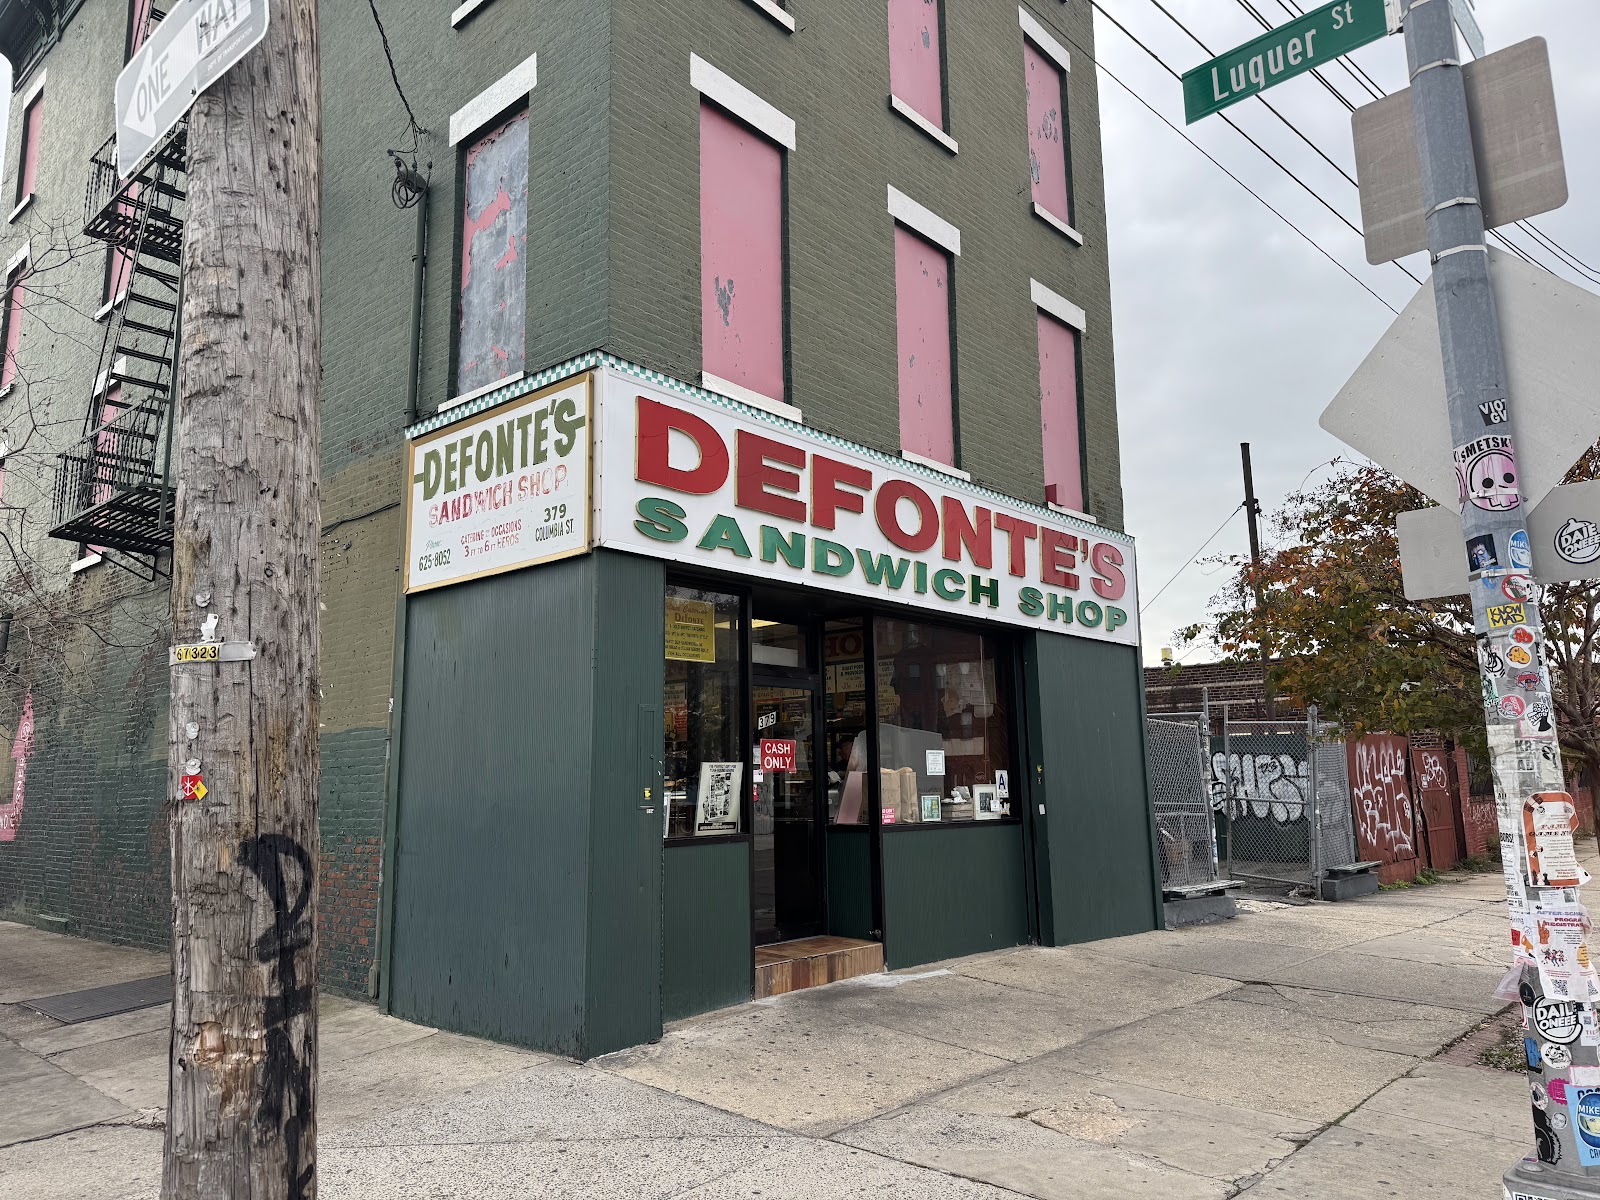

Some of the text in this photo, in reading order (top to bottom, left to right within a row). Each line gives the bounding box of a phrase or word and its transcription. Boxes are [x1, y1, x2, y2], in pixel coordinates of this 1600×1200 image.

[1211, 1, 1354, 102] Luquer St
[137, 52, 171, 122] ONE
[423, 398, 577, 501] DEFONTE'S
[428, 464, 568, 528] SANDWICH SHOP
[634, 395, 1126, 600] DEFONTE'S
[544, 503, 567, 523] 379
[460, 530, 485, 546] CATERING
[490, 519, 522, 538] OCCASIONS
[535, 521, 564, 542] COLUMBIA
[464, 545, 470, 558] 3
[484, 540, 490, 552] 6
[497, 532, 520, 549] HEROS
[418, 548, 451, 572] 625-8052
[633, 497, 1128, 632] SANDWICH SHOP
[1490, 604, 1521, 617] KNOW
[1491, 613, 1525, 626] MAD
[176, 645, 217, 661] 67323
[759, 713, 776, 729] 379
[765, 743, 790, 755] CASH
[764, 756, 792, 769] ONLY
[998, 773, 1006, 790] A
[1538, 1015, 1577, 1031] ONEEE
